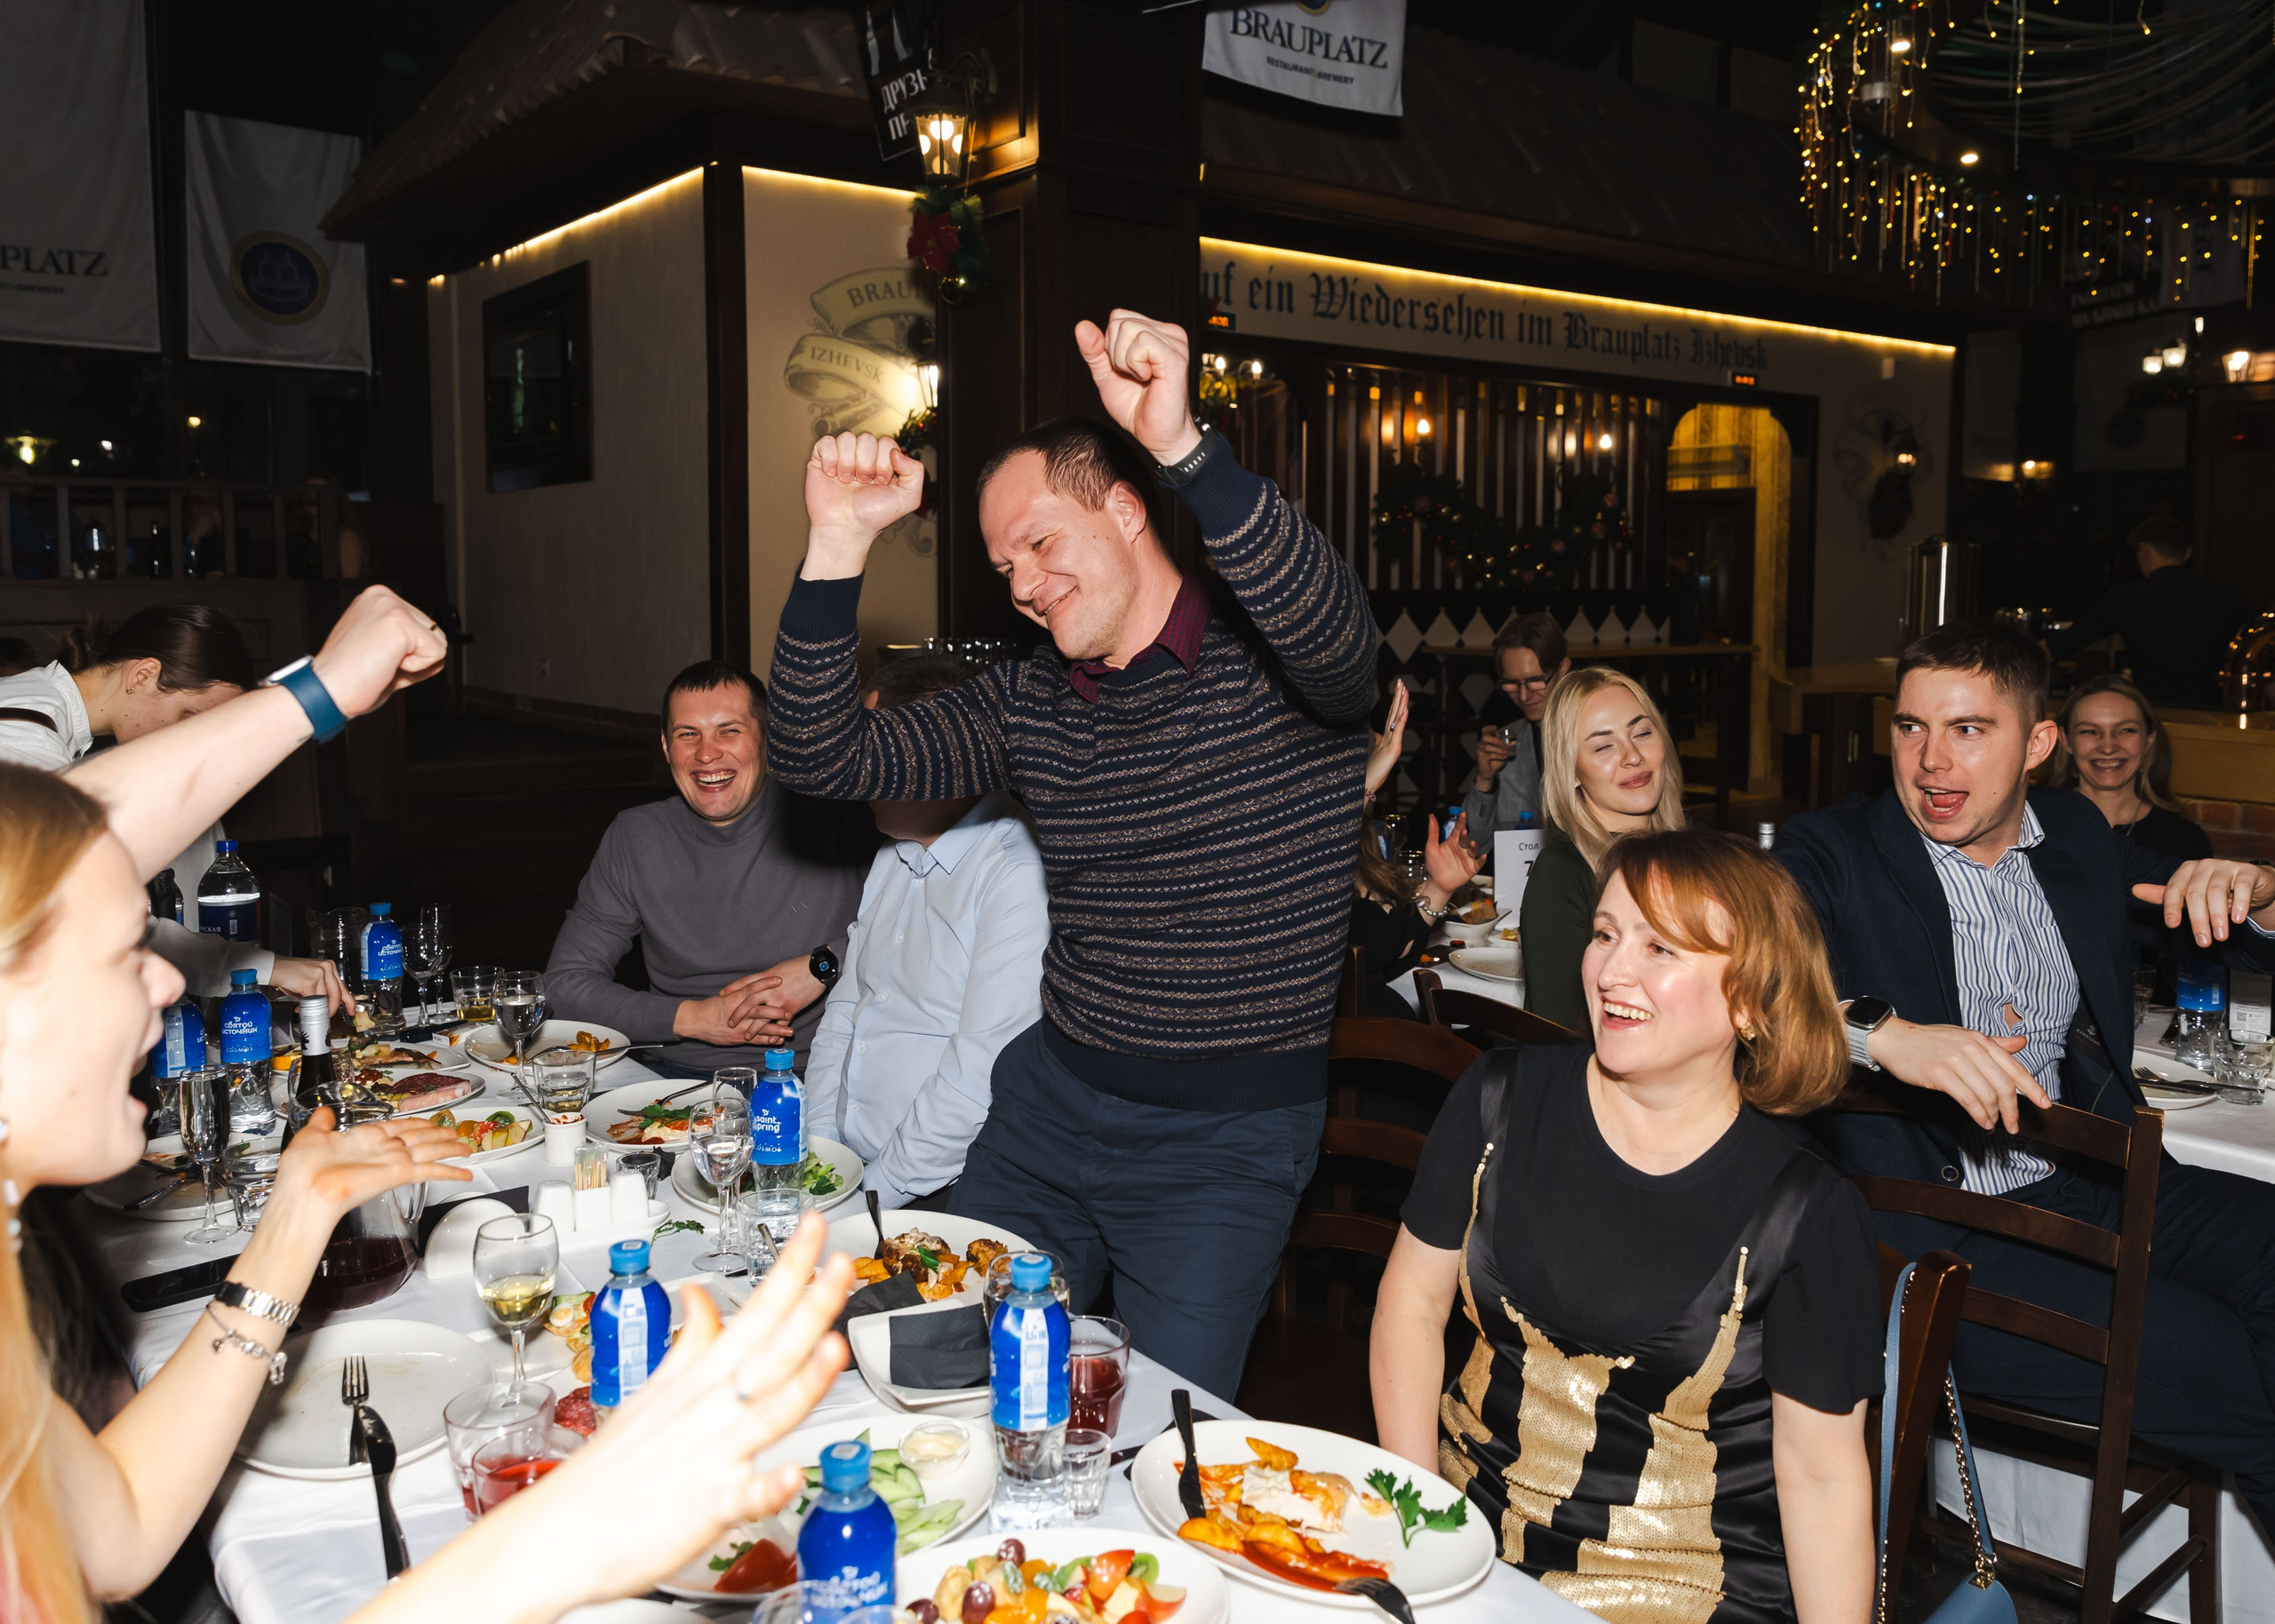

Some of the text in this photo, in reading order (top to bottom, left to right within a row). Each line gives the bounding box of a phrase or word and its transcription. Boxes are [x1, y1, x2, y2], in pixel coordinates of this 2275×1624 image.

[1231, 9, 1388, 69] BRAUPLATZ
[1265, 55, 1355, 85] RESTAURANT BREWERY
[881, 68, 928, 115] ДРУЗЬ
[0, 244, 109, 276] PLATZ
[847, 281, 920, 308] BRAU
[1201, 260, 1768, 371] uf ein Wiedersehen im Brauplatz Izhevsk
[810, 346, 884, 384] IZHEVSK
[1519, 842, 1539, 851] Стол
[1524, 860, 1534, 877] 7
